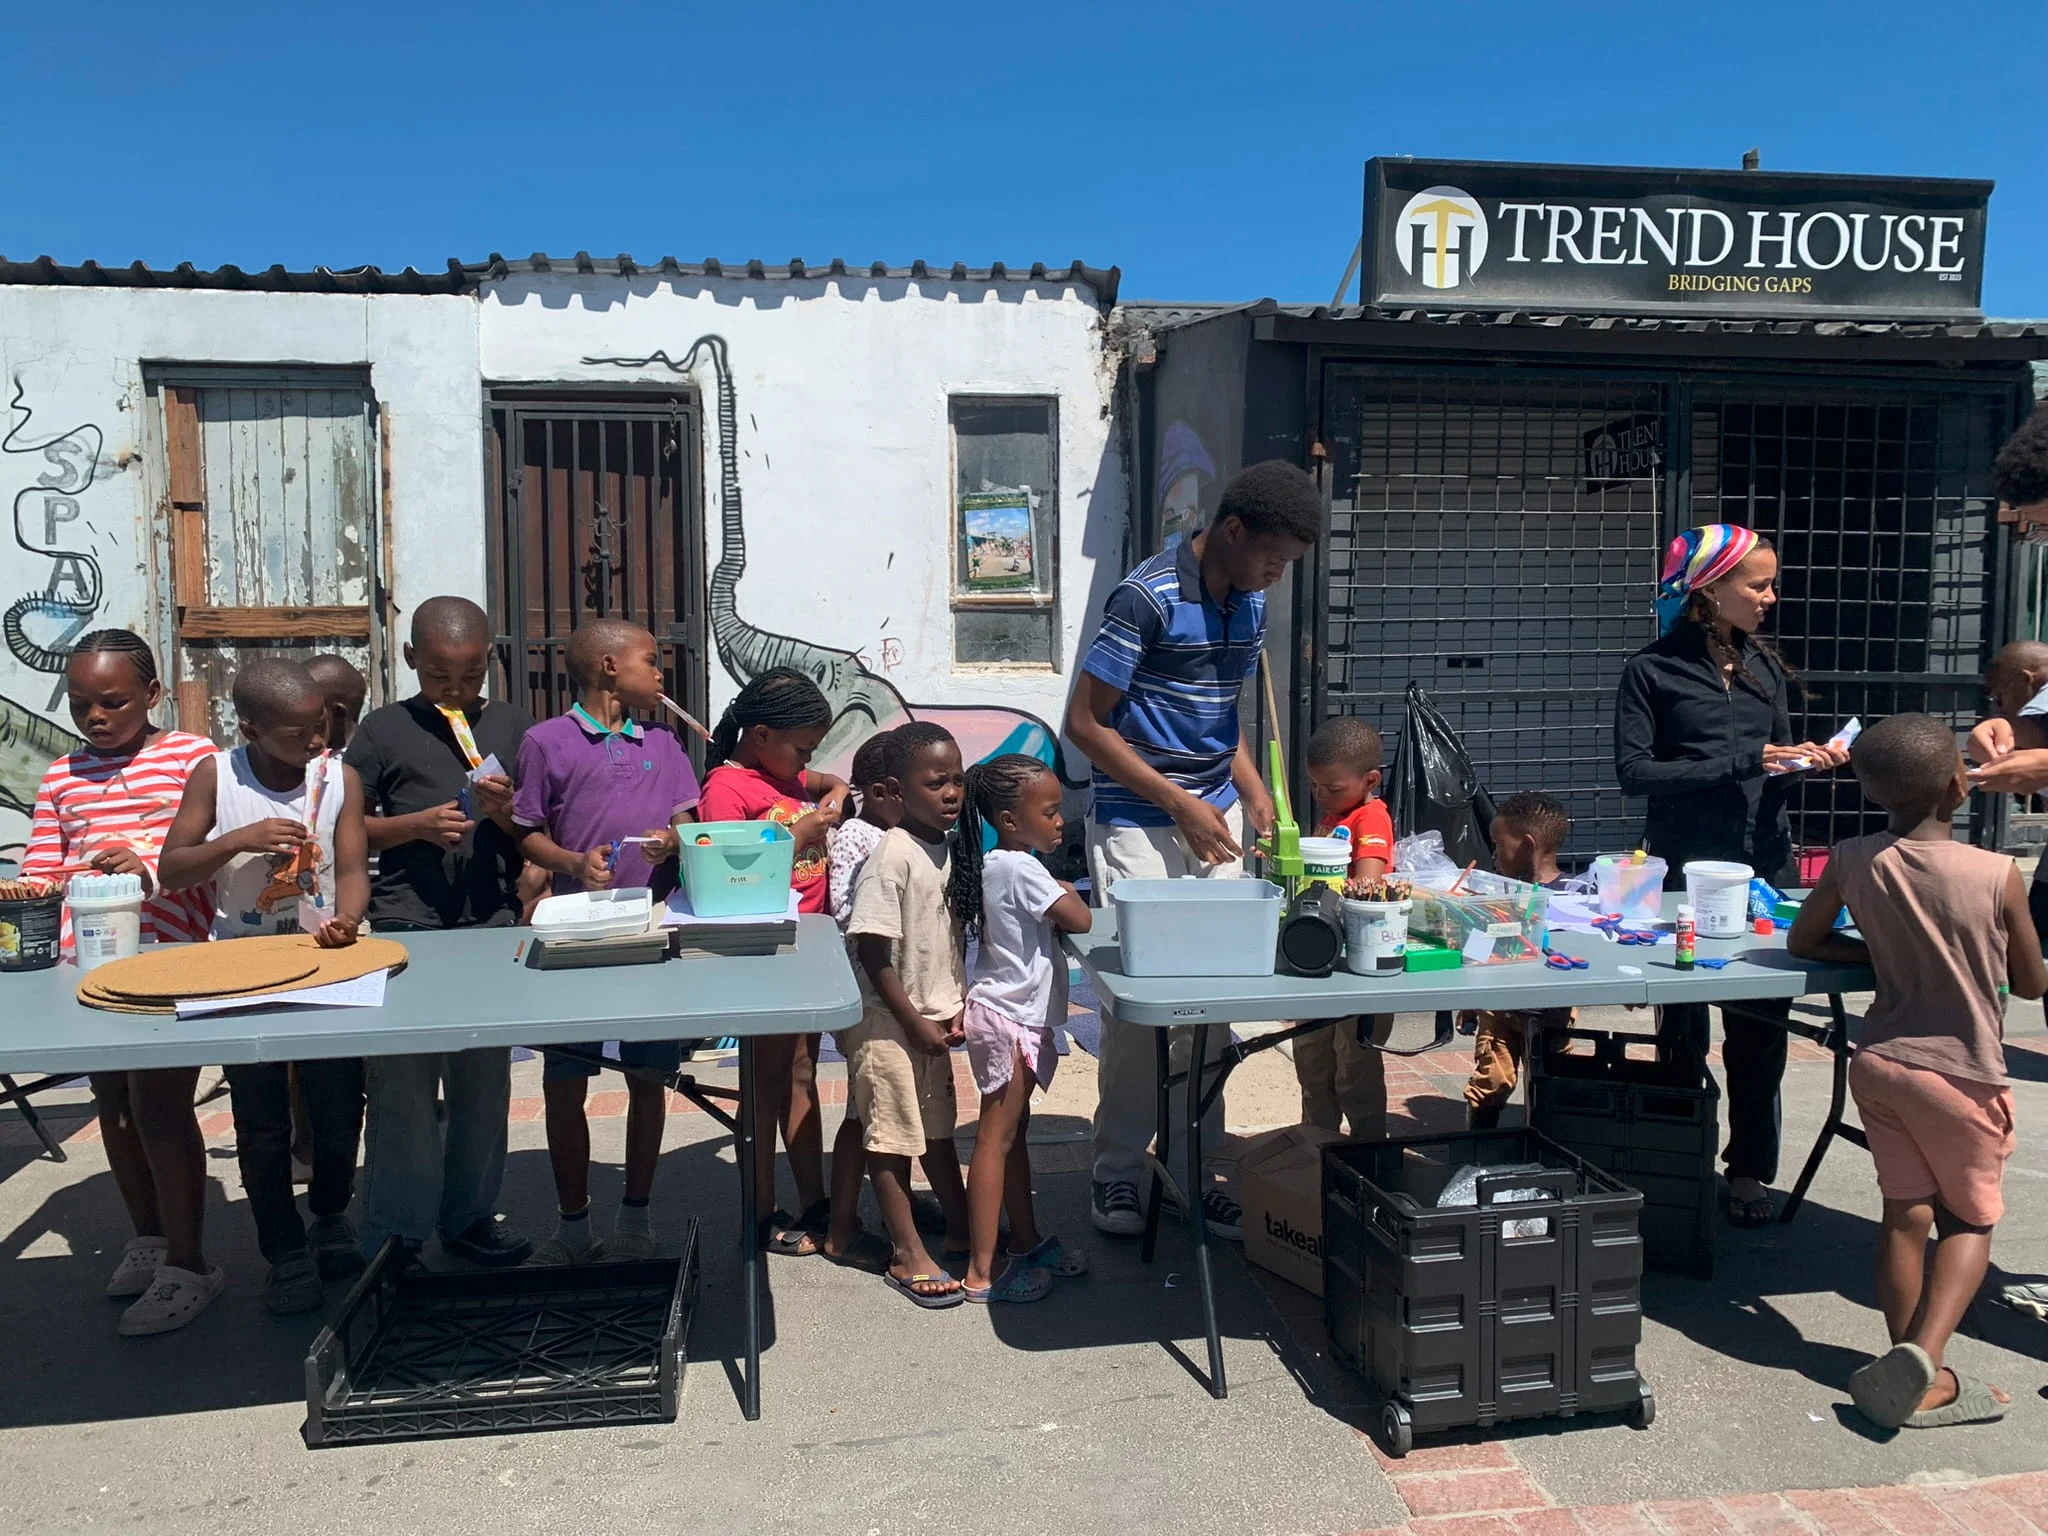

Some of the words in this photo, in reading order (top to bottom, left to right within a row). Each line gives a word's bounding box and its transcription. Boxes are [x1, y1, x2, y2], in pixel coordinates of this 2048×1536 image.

[1498, 201, 1735, 267] TREND
[1744, 210, 1966, 273] HOUSE
[1668, 274, 1760, 292] BRIDGING
[1764, 276, 1812, 293] GAPS
[1311, 866, 1330, 874] FAIR
